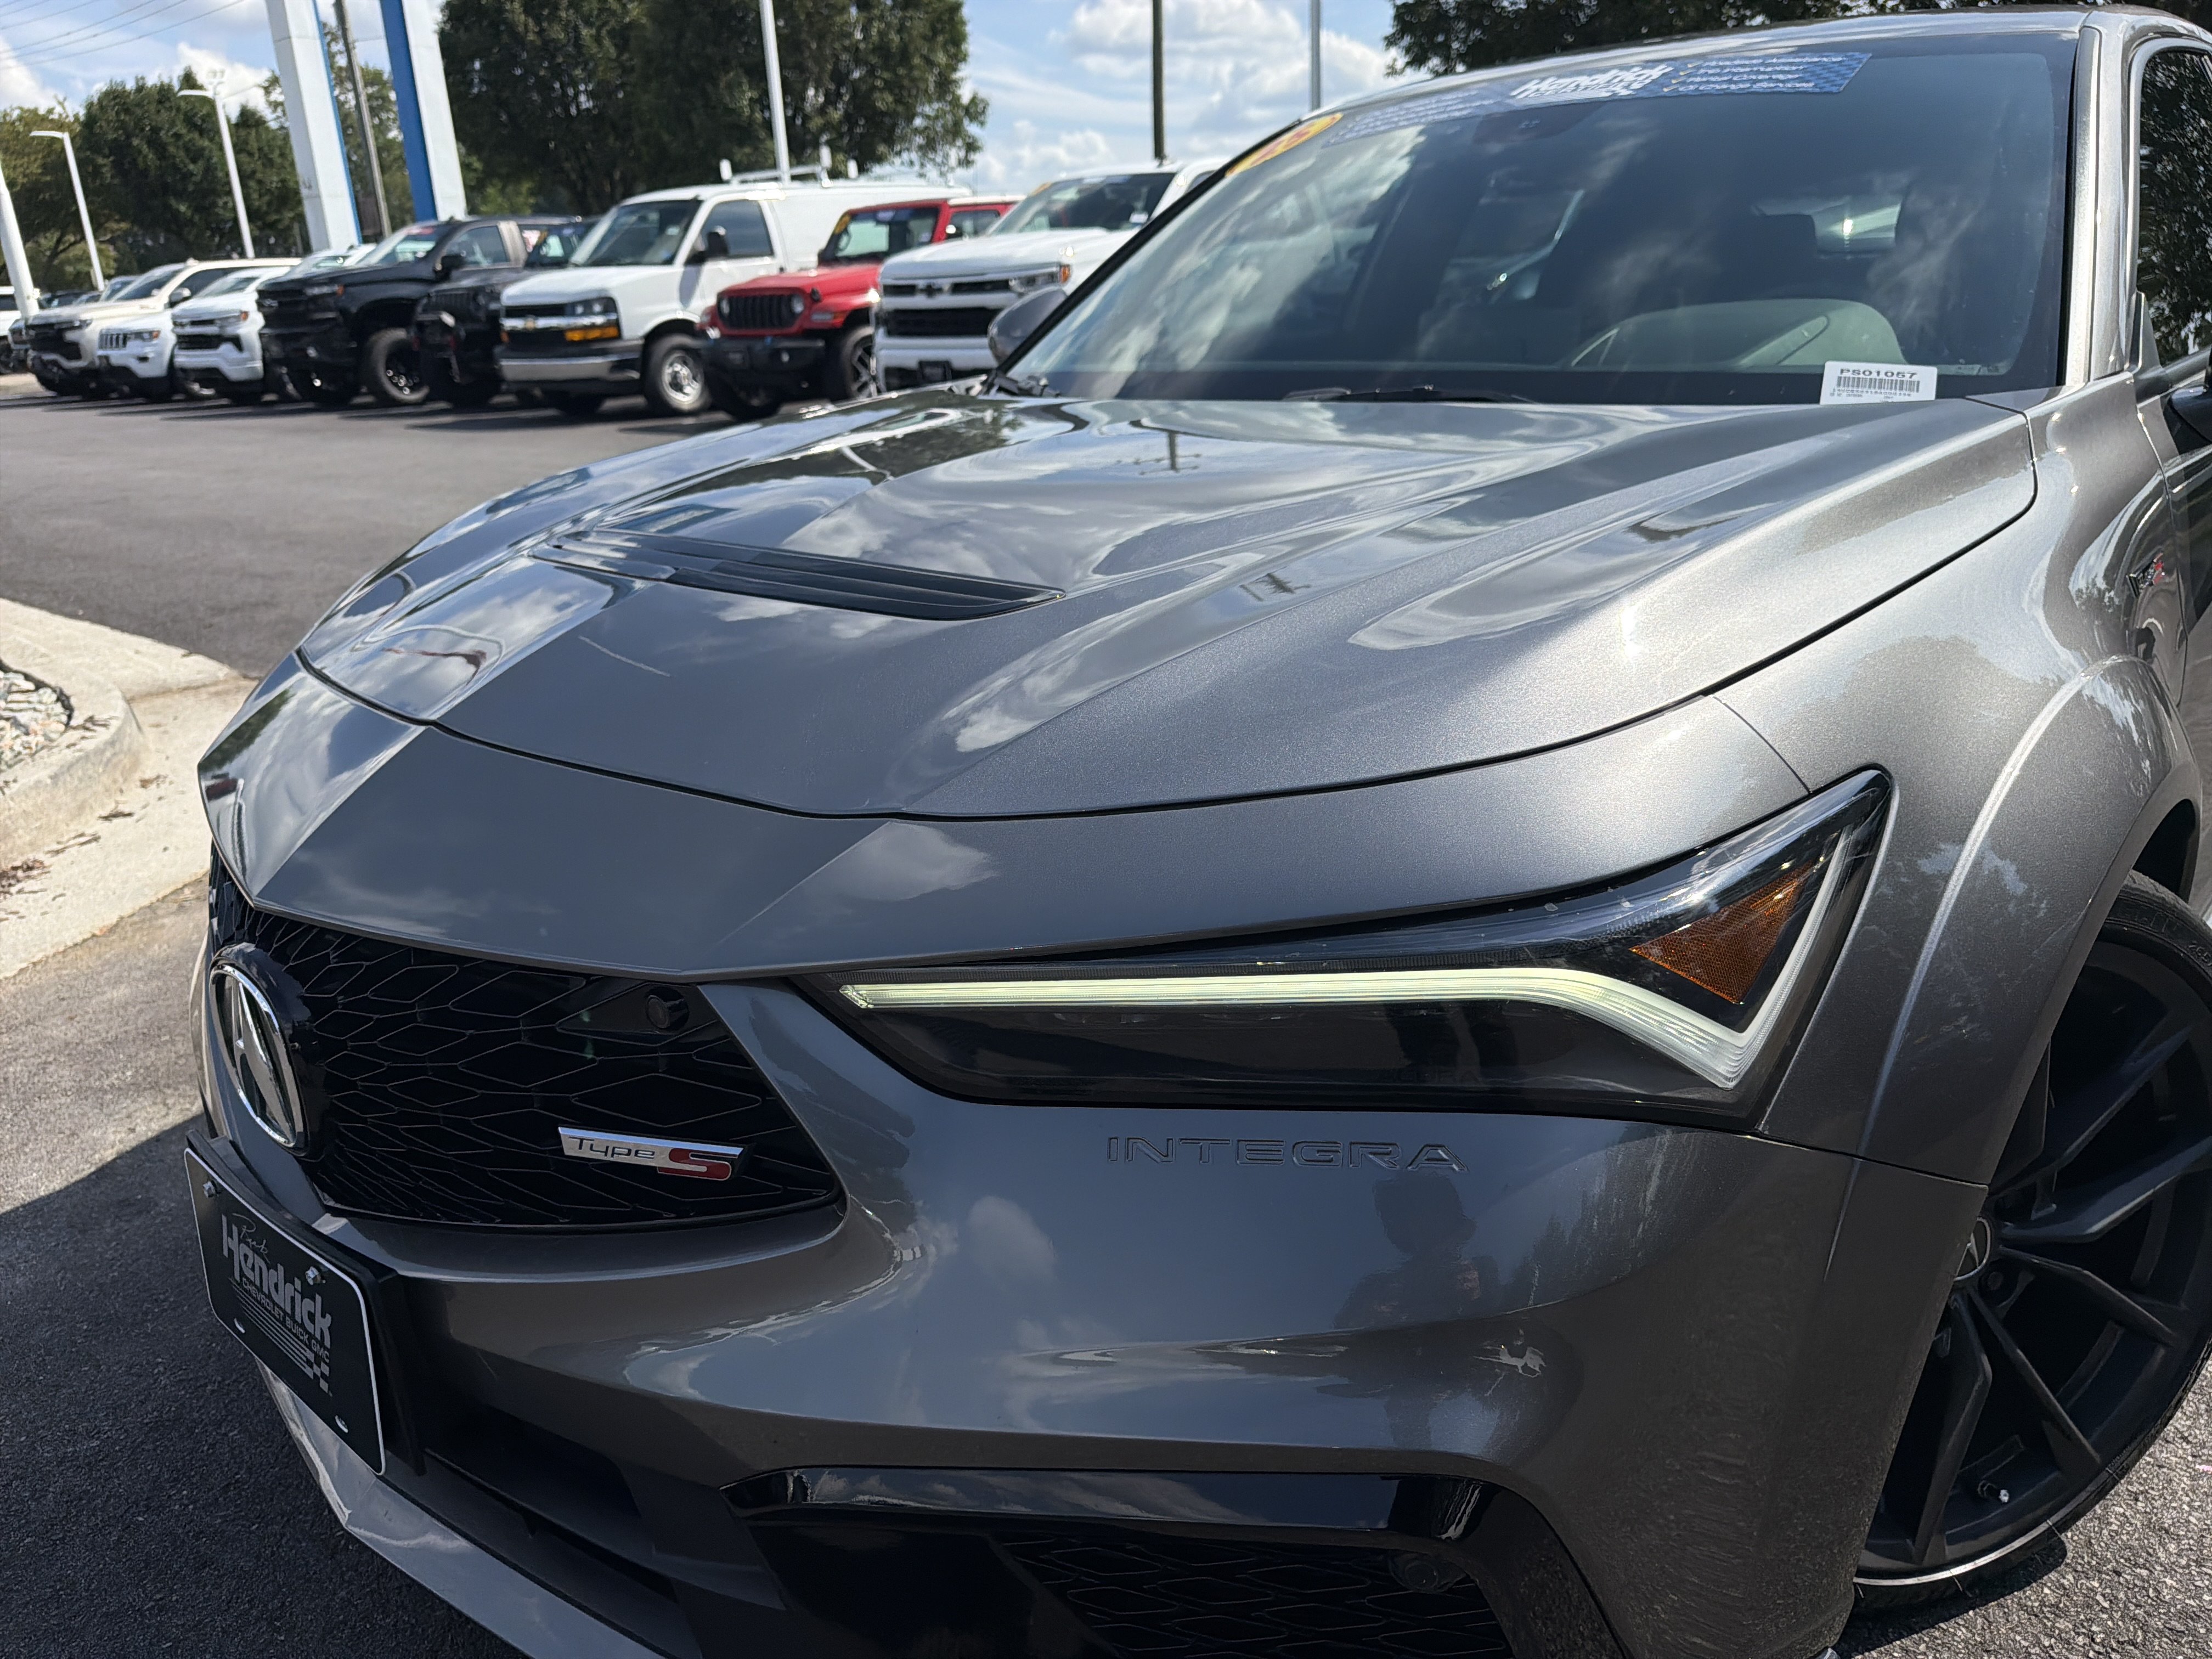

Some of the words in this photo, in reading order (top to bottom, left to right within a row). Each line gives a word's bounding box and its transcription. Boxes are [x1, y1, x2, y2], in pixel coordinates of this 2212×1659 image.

[1509, 63, 1674, 99] Hendrick
[568, 1136, 655, 1160] Type
[657, 1147, 738, 1181] S
[1107, 1137, 1469, 1172] INTEGRA
[222, 1213, 332, 1349] Hendrick
[242, 1277, 285, 1321] CHEVROLET
[285, 1316, 309, 1345] BUICK
[311, 1339, 330, 1363] GMC
